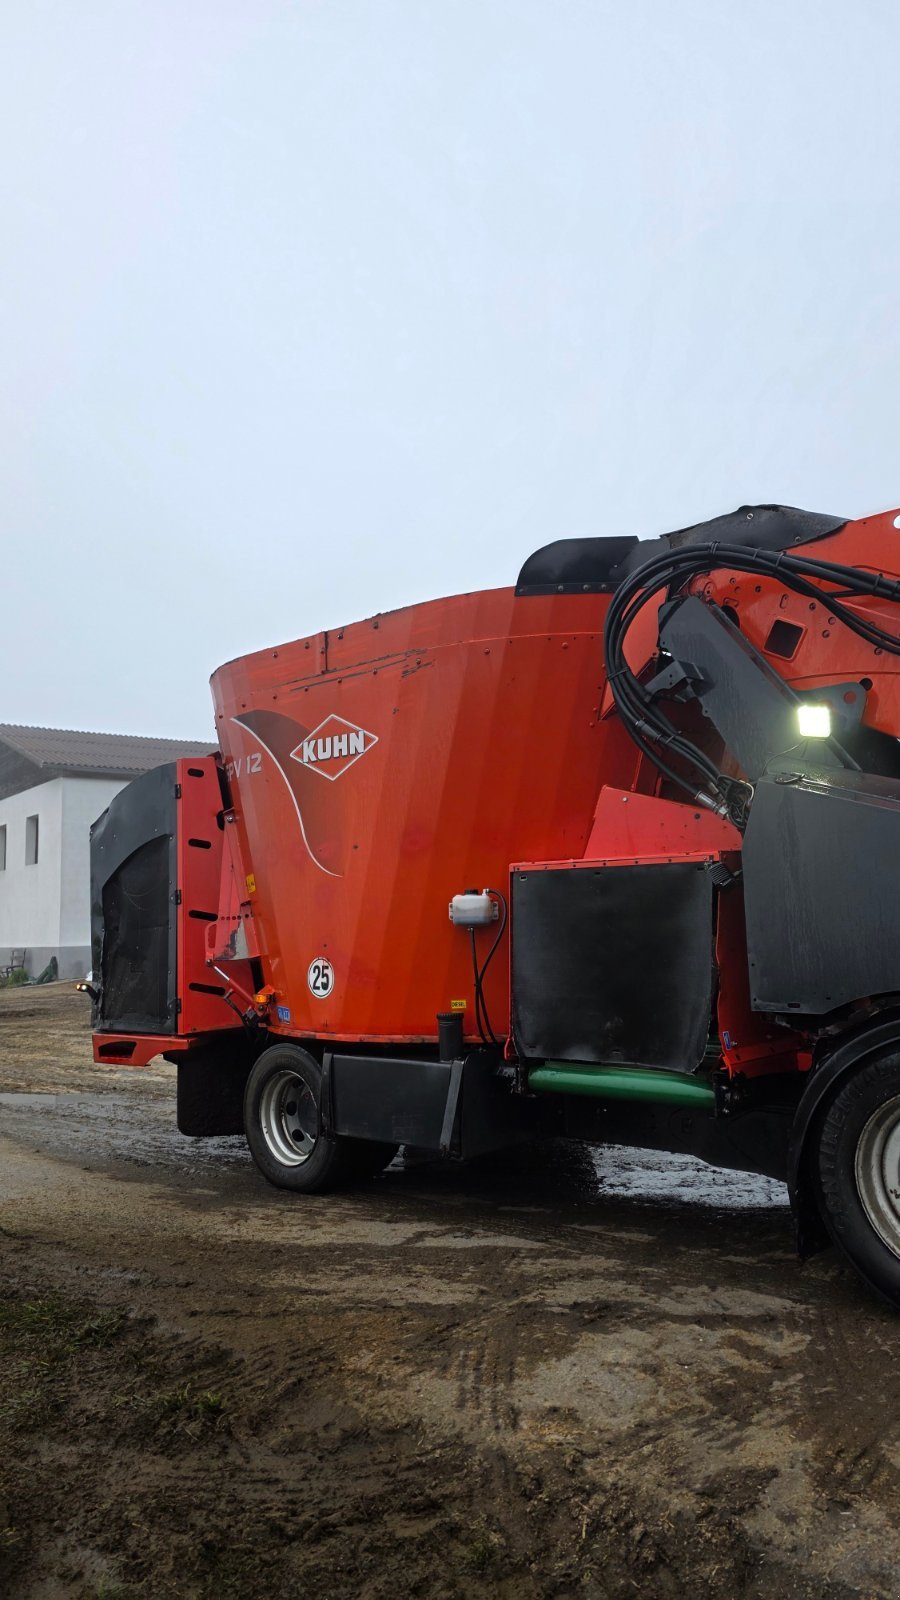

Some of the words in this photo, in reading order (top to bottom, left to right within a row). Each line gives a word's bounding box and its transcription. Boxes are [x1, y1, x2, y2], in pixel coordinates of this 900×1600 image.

[302, 730, 366, 763] KUHN
[225, 758, 242, 782] PV
[246, 752, 262, 774] 12
[312, 964, 330, 991] 25
